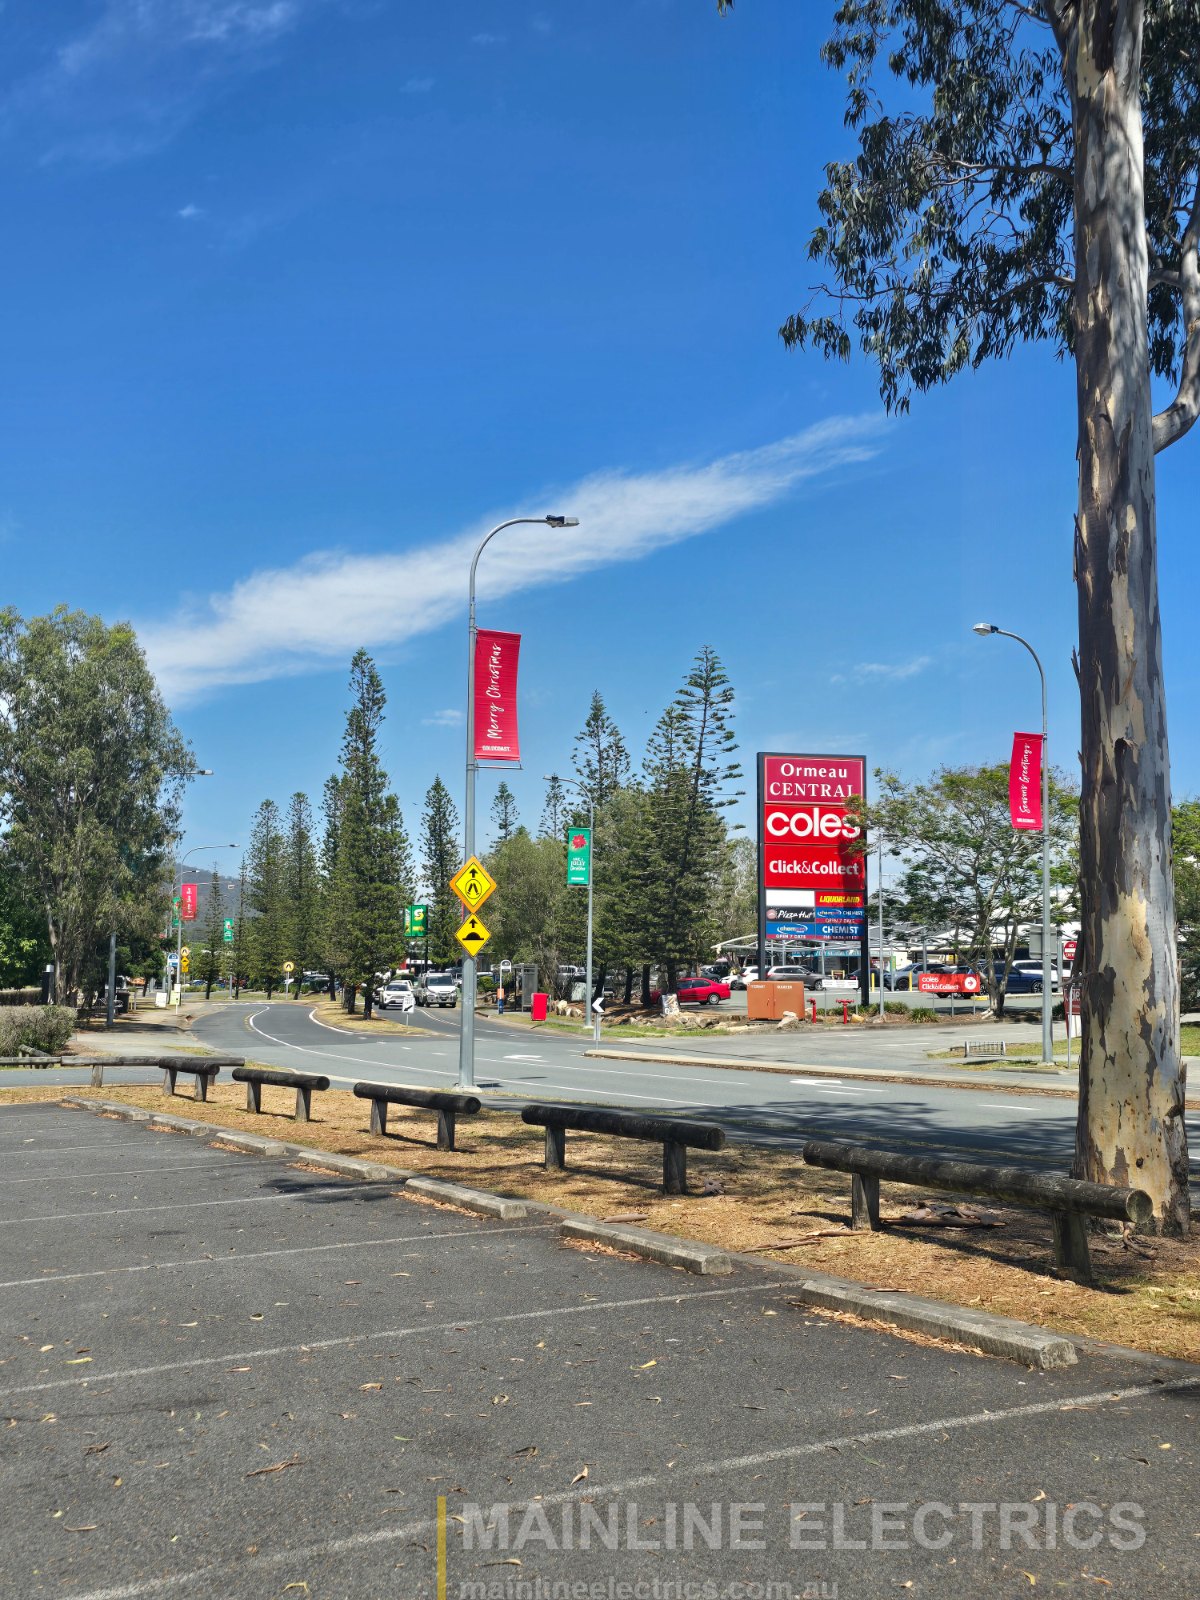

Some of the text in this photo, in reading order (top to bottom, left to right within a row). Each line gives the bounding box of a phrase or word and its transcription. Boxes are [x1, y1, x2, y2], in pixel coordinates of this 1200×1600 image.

[485, 642, 504, 739] Merry Christmas
[780, 763, 847, 778] Ormeau
[1018, 743, 1032, 783] Greetings
[766, 807, 861, 838] coles
[769, 859, 859, 875] Click&Collect
[819, 895, 860, 903] LIQUORLAND
[777, 910, 812, 919] Pizza Hut
[822, 926, 859, 934] CHEMIST
